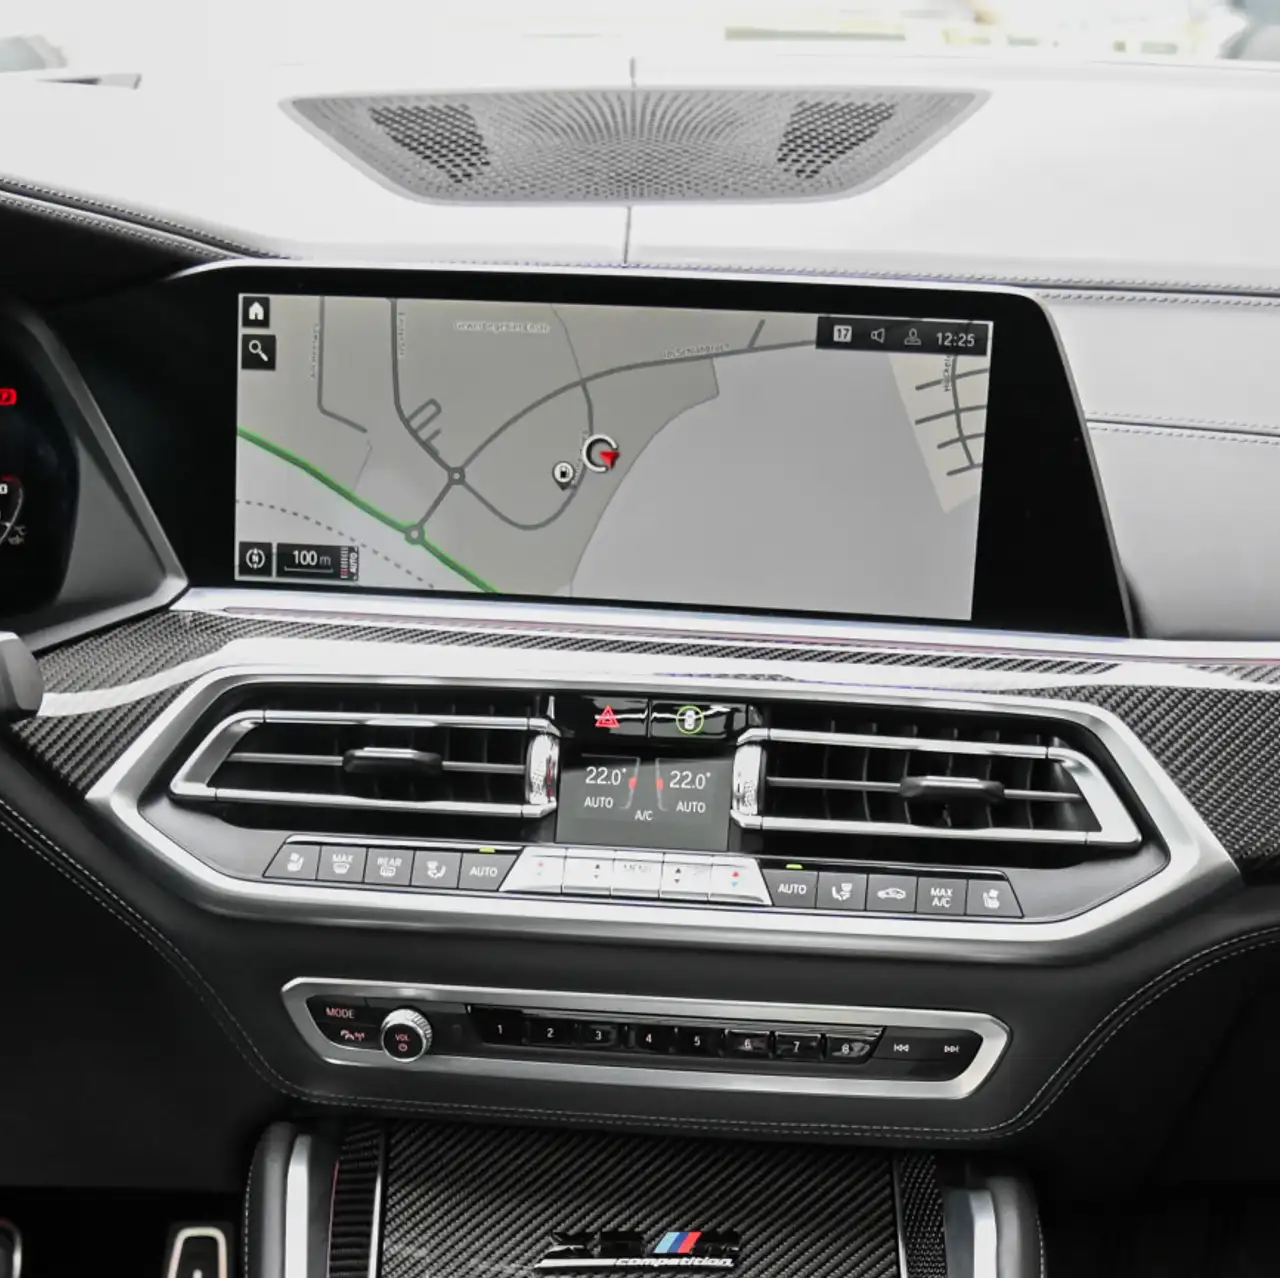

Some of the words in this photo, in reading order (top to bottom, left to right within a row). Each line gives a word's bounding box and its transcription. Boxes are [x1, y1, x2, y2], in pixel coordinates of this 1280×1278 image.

[835, 327, 851, 340] 17
[936, 332, 975, 347] 12:25
[293, 550, 318, 566] 100
[319, 556, 331, 566] m
[584, 796, 614, 809] AUTO
[676, 801, 706, 813] AUTO
[634, 809, 654, 821] A/C
[332, 854, 354, 864] MAX
[377, 857, 403, 868] REAR
[469, 866, 498, 877] AUTO
[778, 884, 807, 895] AUTO
[930, 887, 953, 898] MAX
[931, 897, 951, 908] A/C
[325, 1007, 355, 1019] MODE
[497, 1024, 503, 1035] 1
[546, 1027, 554, 1039] 2
[394, 1033, 409, 1041] VOL
[595, 1030, 603, 1041] 3
[645, 1033, 652, 1044] 4
[694, 1035, 701, 1047] 5
[793, 1041, 801, 1053] 7
